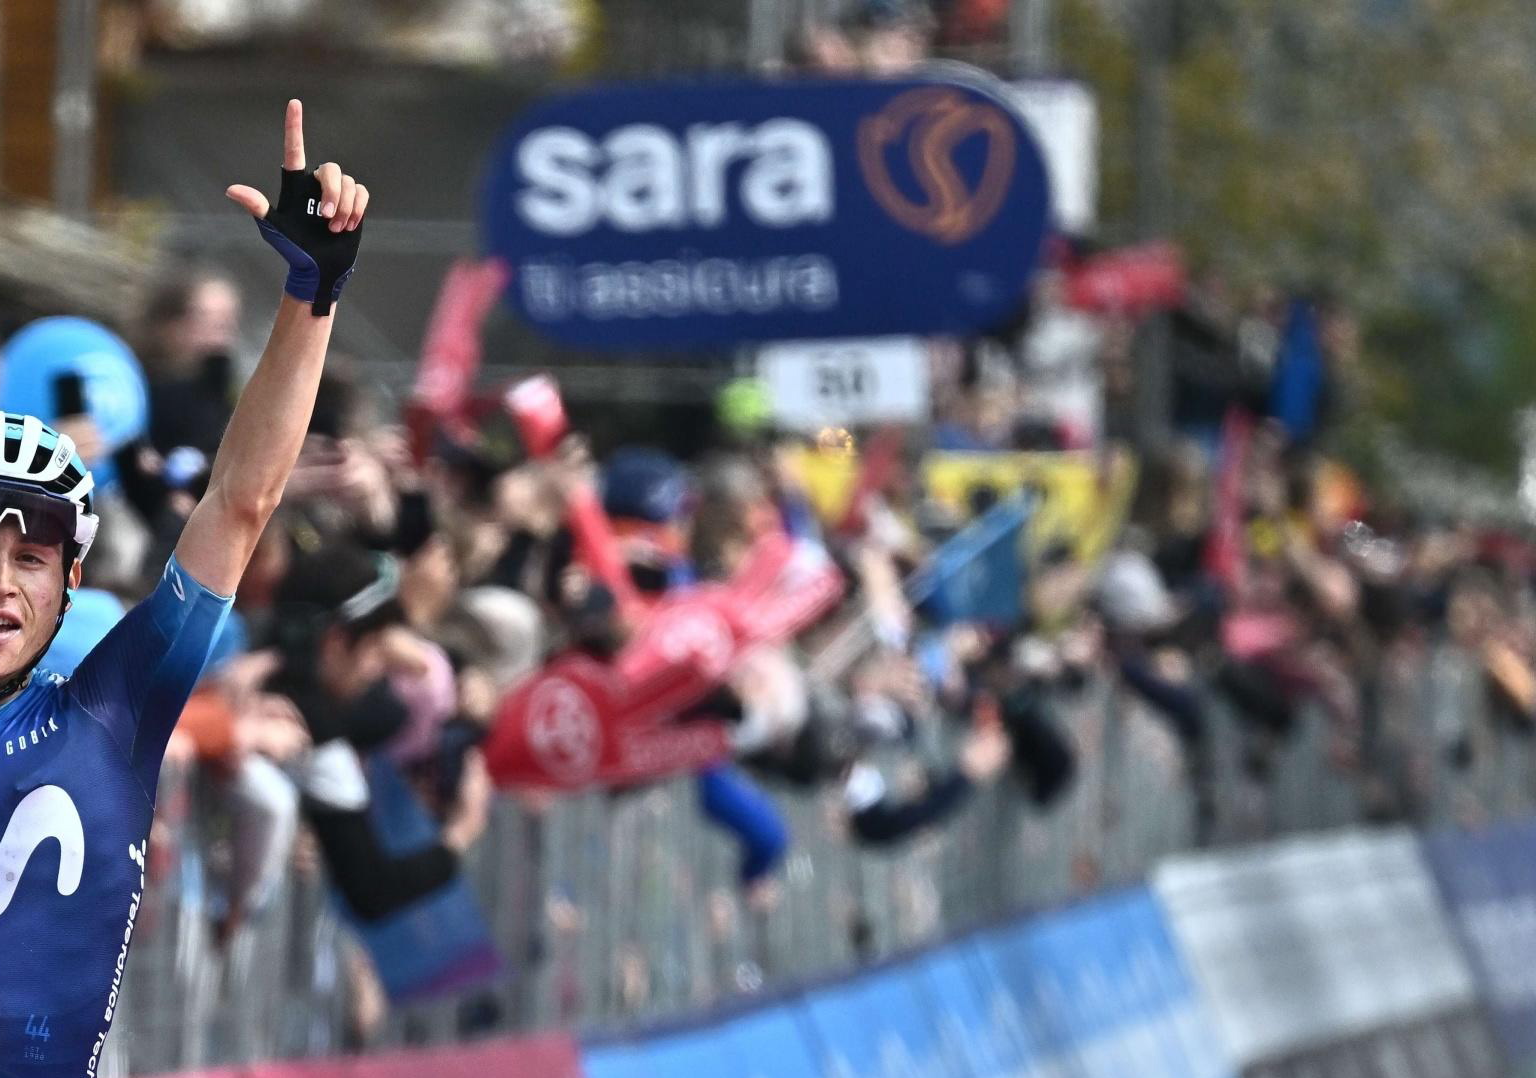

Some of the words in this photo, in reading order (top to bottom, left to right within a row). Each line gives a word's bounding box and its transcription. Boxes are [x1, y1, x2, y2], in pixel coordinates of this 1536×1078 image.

[516, 118, 834, 237] sara
[5, 716, 59, 756] GOBIK
[24, 1013, 51, 1042] 44
